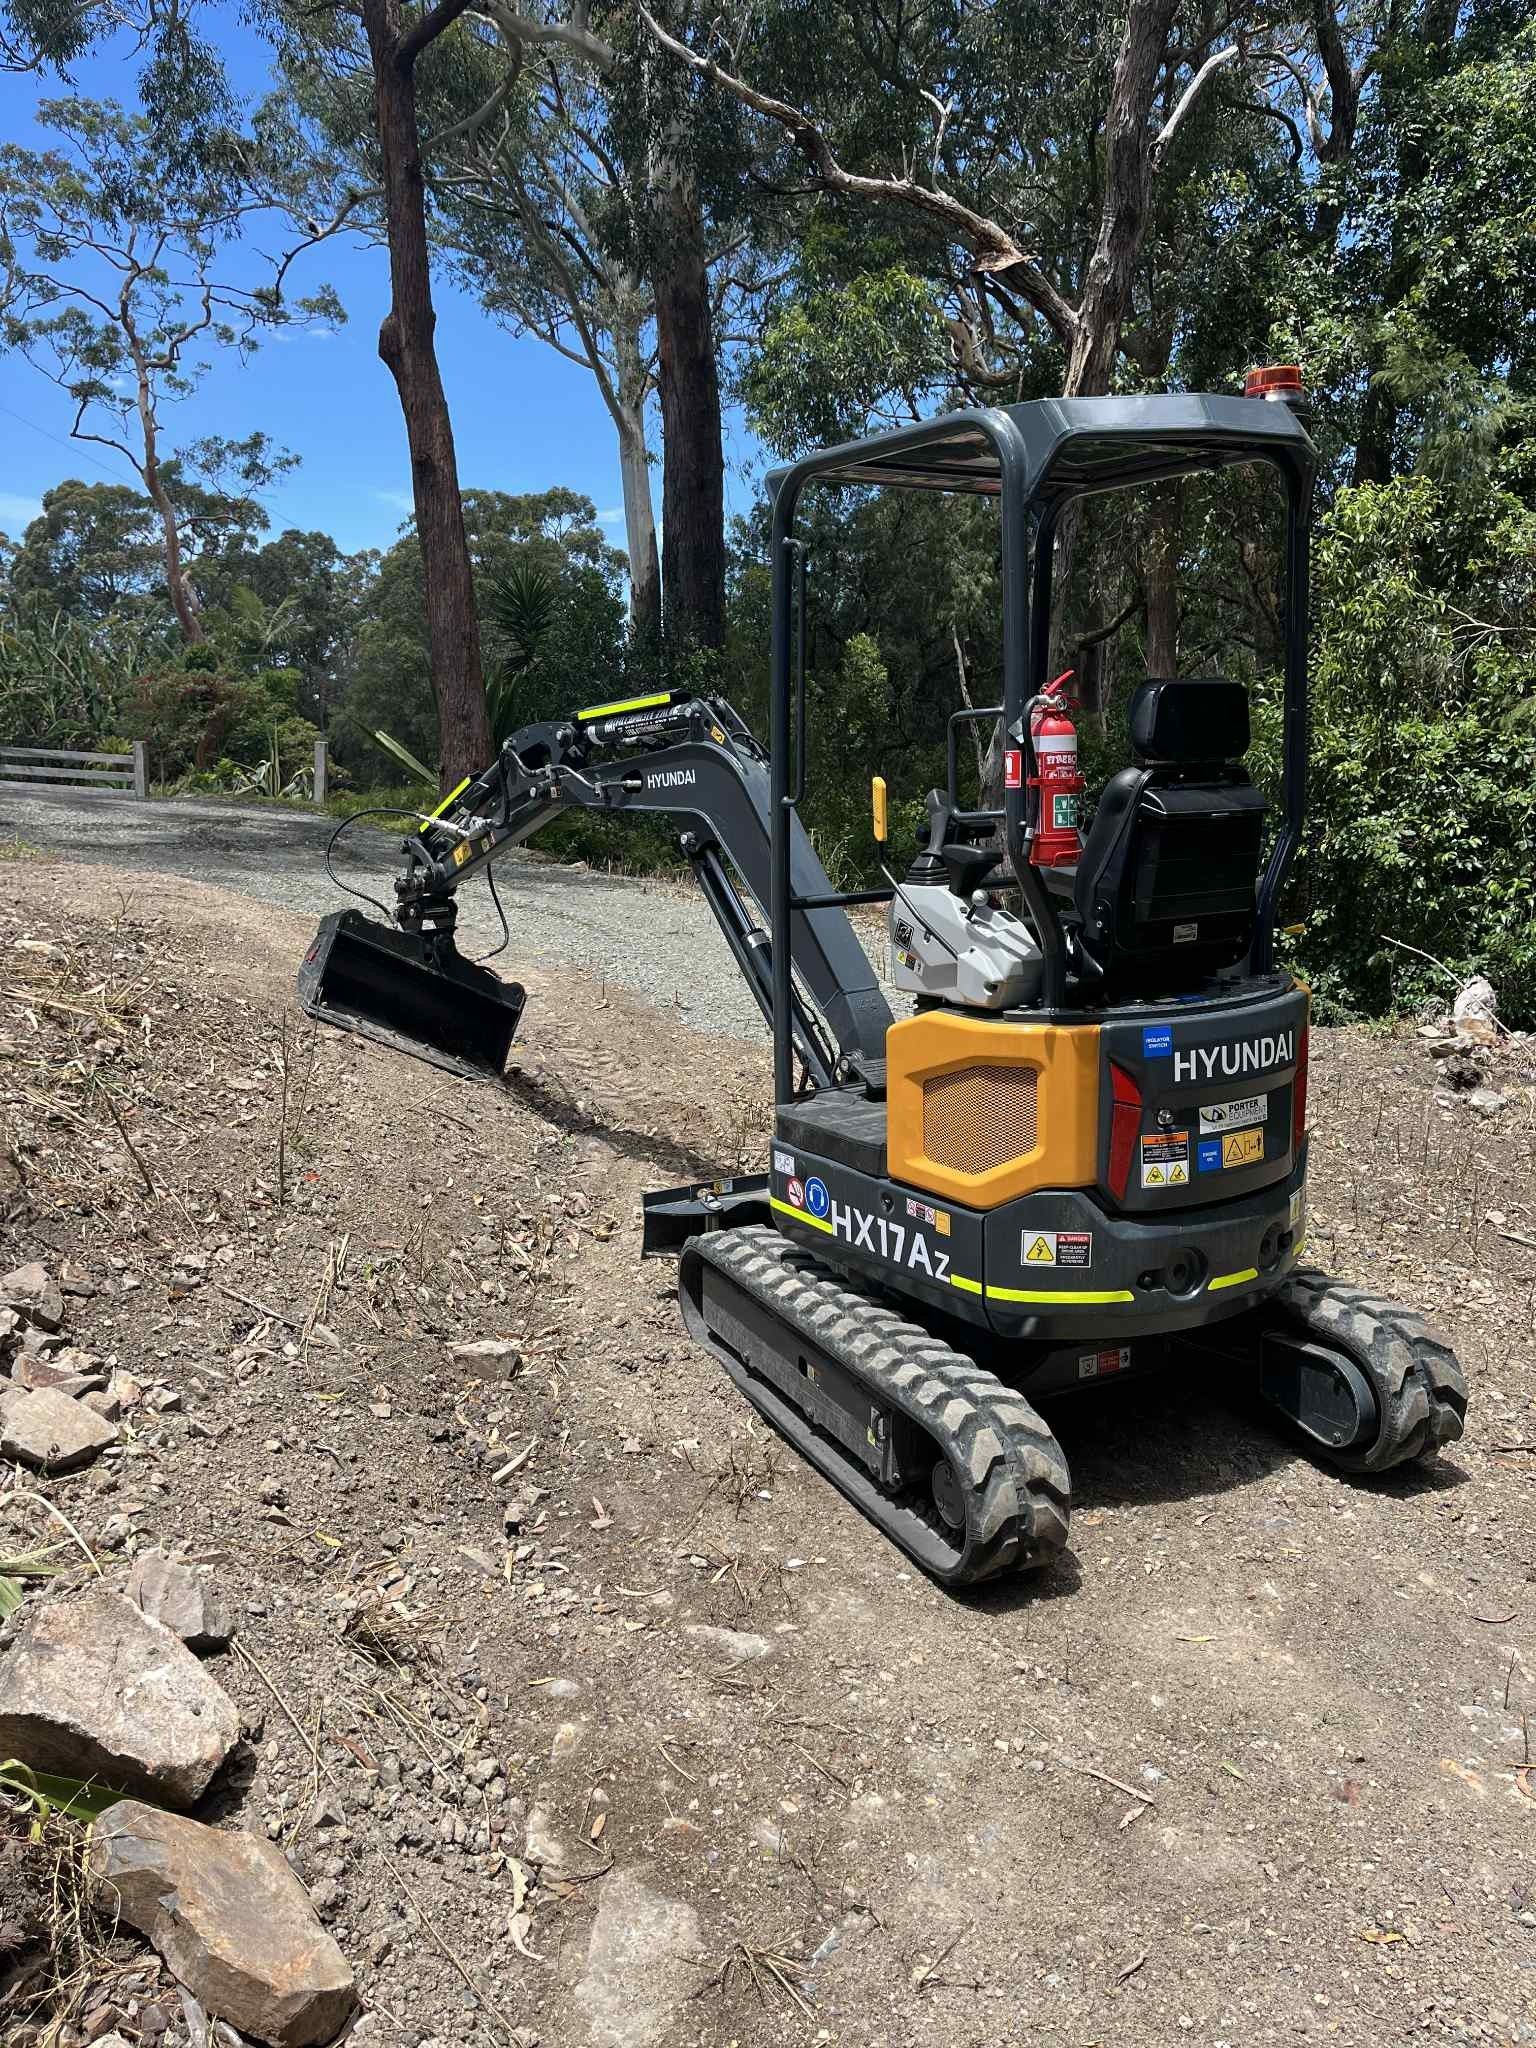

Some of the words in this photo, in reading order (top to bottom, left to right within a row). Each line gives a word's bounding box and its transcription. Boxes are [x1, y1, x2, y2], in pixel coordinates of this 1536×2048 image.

[647, 769, 696, 789] HYUNDAI
[1174, 1030, 1293, 1082] HYUNDAI
[1228, 1099, 1259, 1112] PORTER
[1229, 1105, 1266, 1121] EQUIPMENT
